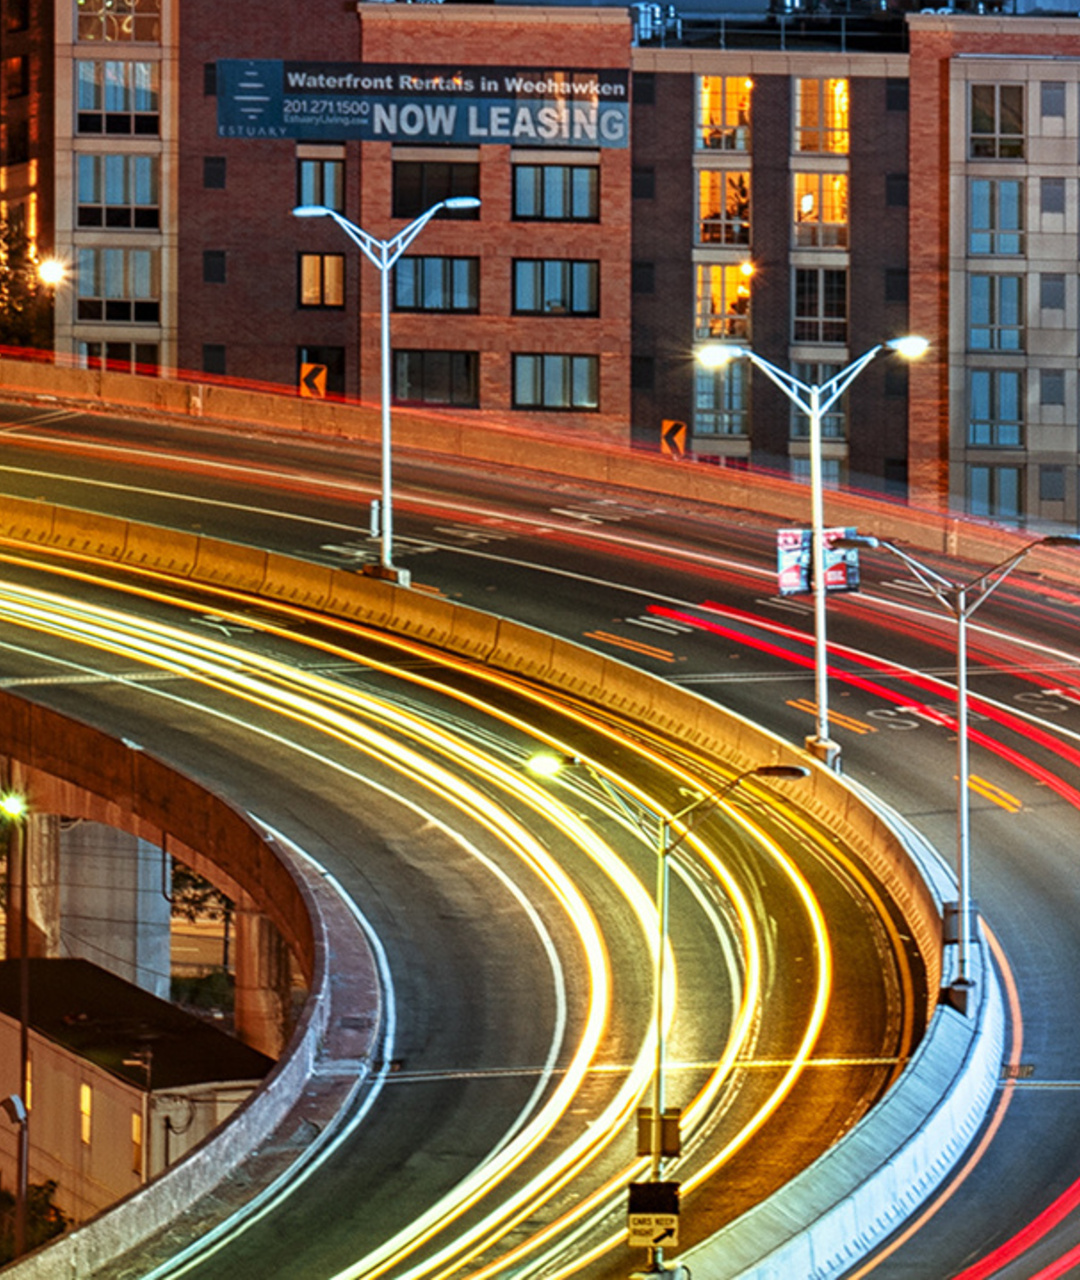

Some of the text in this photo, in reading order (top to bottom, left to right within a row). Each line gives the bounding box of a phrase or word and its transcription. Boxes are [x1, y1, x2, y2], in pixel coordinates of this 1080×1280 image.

[287, 72, 626, 96] Waterfront Rentals in Weehawken
[219, 126, 287, 137] ESTUARY
[373, 101, 624, 141] NOW LEASING
